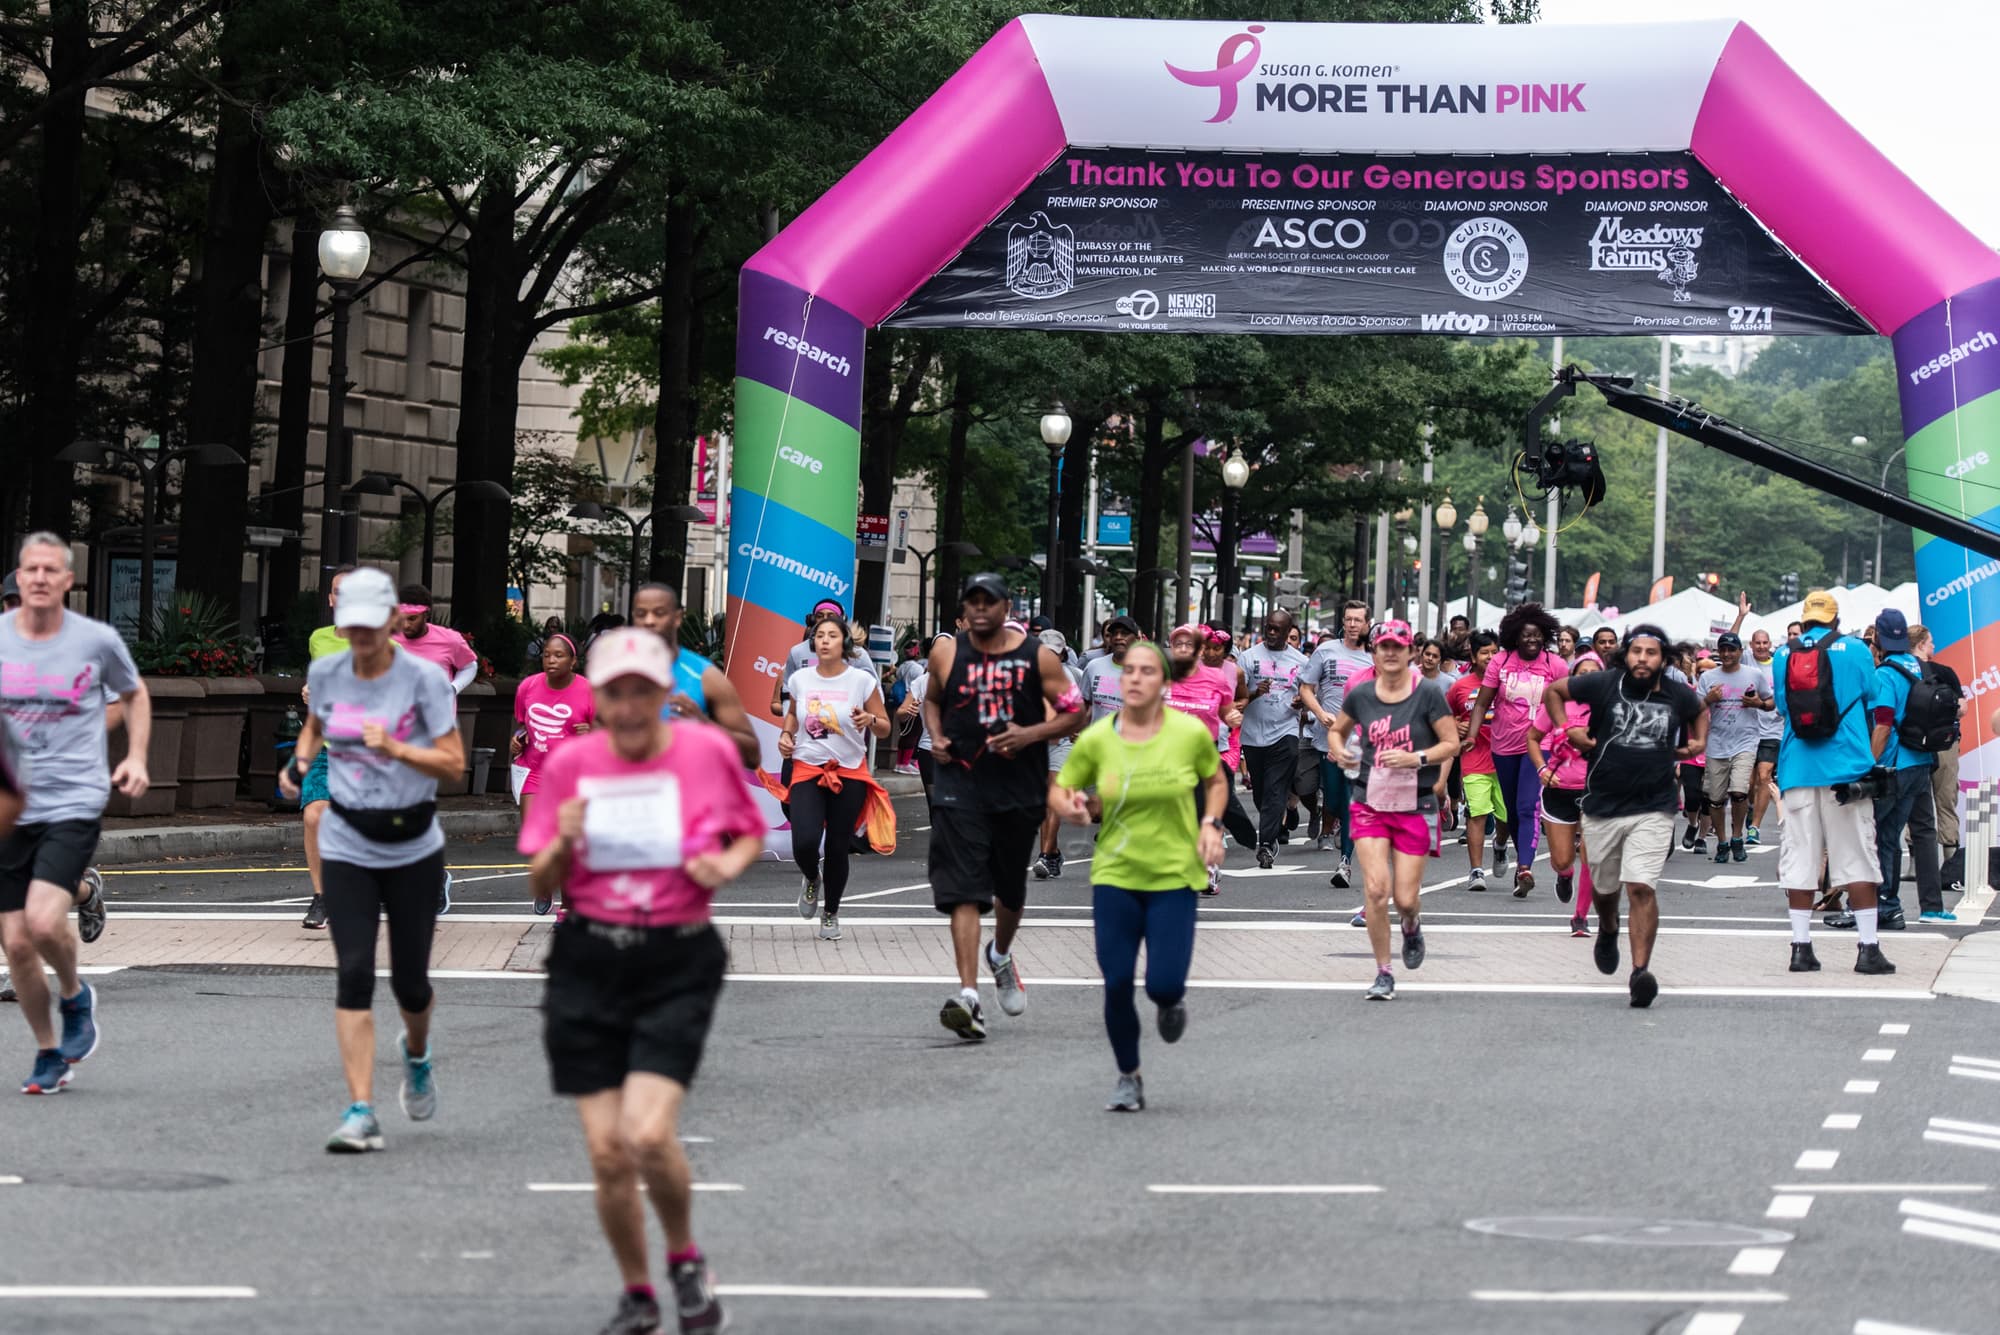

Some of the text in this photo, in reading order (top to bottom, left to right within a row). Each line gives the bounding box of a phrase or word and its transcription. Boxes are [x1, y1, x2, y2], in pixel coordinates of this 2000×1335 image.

[1256, 83, 1587, 114] MORE THAN PINK
[1067, 160, 1689, 195] Thank You To Our Generous Sponsors
[1047, 197, 1158, 209] PREMIER SPONSOR
[1241, 200, 1377, 211] PRESENTING SPONSOR
[1424, 201, 1548, 212] DIAMOND SPONSOR
[1585, 201, 1709, 212] DIAMOND SPONSOR
[1455, 222, 1517, 244] CUISINE
[1592, 216, 1704, 248] Meadows
[1076, 242, 1152, 250] EMBASSY OF THE
[1076, 254, 1184, 264] UNITED ARAB EMIRATES
[1588, 240, 1668, 271] Farms
[1076, 267, 1158, 277] WASHINGTON, DC
[1247, 265, 1278, 273] WORLD
[1294, 266, 1344, 274] DIFFERENCE
[1346, 266, 1356, 274] IN
[1394, 266, 1416, 274] CARE
[1451, 268, 1522, 297] SOLUTIONS
[1168, 294, 1216, 318] NEWS 8
[1168, 308, 1203, 318] CHANNEL
[964, 310, 996, 321] Local
[998, 310, 1053, 322] Television
[1250, 314, 1412, 328] Local News Radio Sponsor:
[1420, 312, 1490, 334] wtop
[1502, 314, 1542, 322] 103.5 FM
[1633, 316, 1721, 326] Promise Circle:
[1728, 306, 1773, 324] 97.1
[1502, 322, 1556, 332] WTOP.COM
[1730, 323, 1773, 331] WASH-FM
[763, 326, 851, 377] research
[1910, 330, 1998, 385] research
[779, 446, 823, 474] care
[1945, 450, 1990, 479] care
[738, 543, 850, 596] community
[959, 659, 1031, 694] JUST
